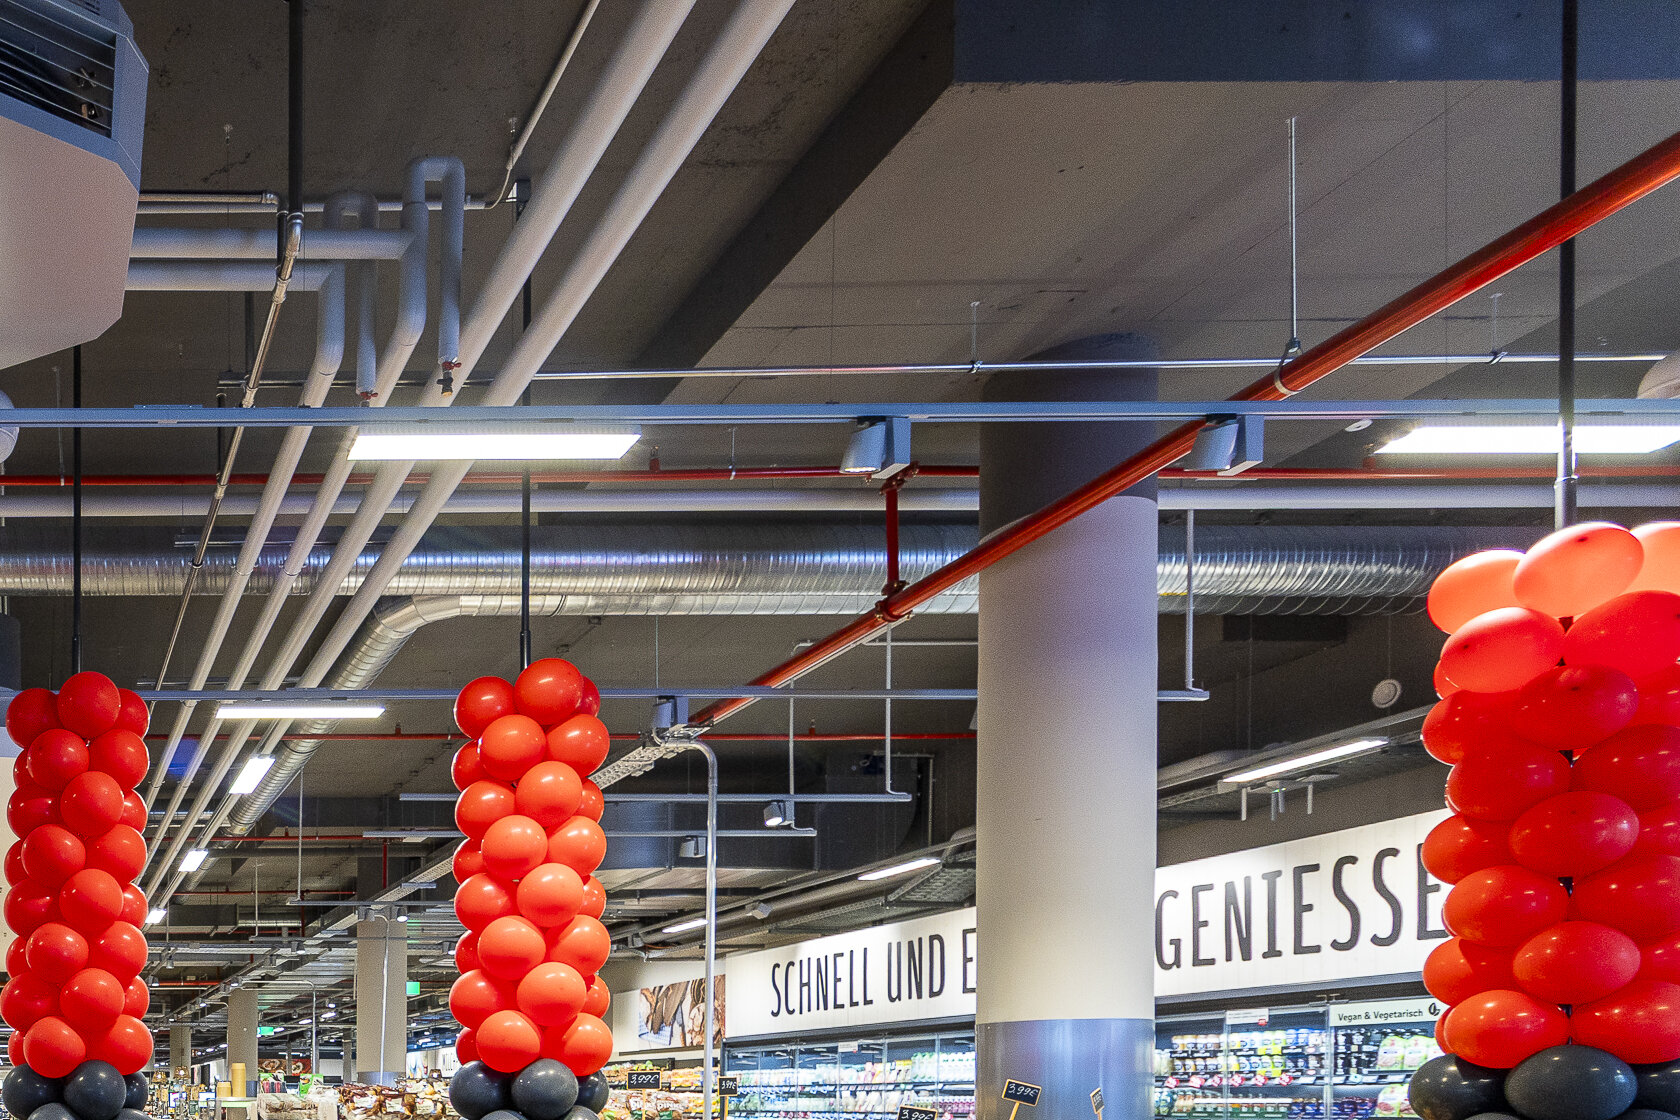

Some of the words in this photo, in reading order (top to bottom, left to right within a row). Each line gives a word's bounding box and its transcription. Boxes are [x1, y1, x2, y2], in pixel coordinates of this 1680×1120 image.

[770, 947, 873, 1018] SCHNELL
[887, 934, 945, 1002] UND
[1338, 1013, 1362, 1022] Vegan
[1364, 1012, 1371, 1020] &
[1373, 1009, 1423, 1021] Vegetarisch
